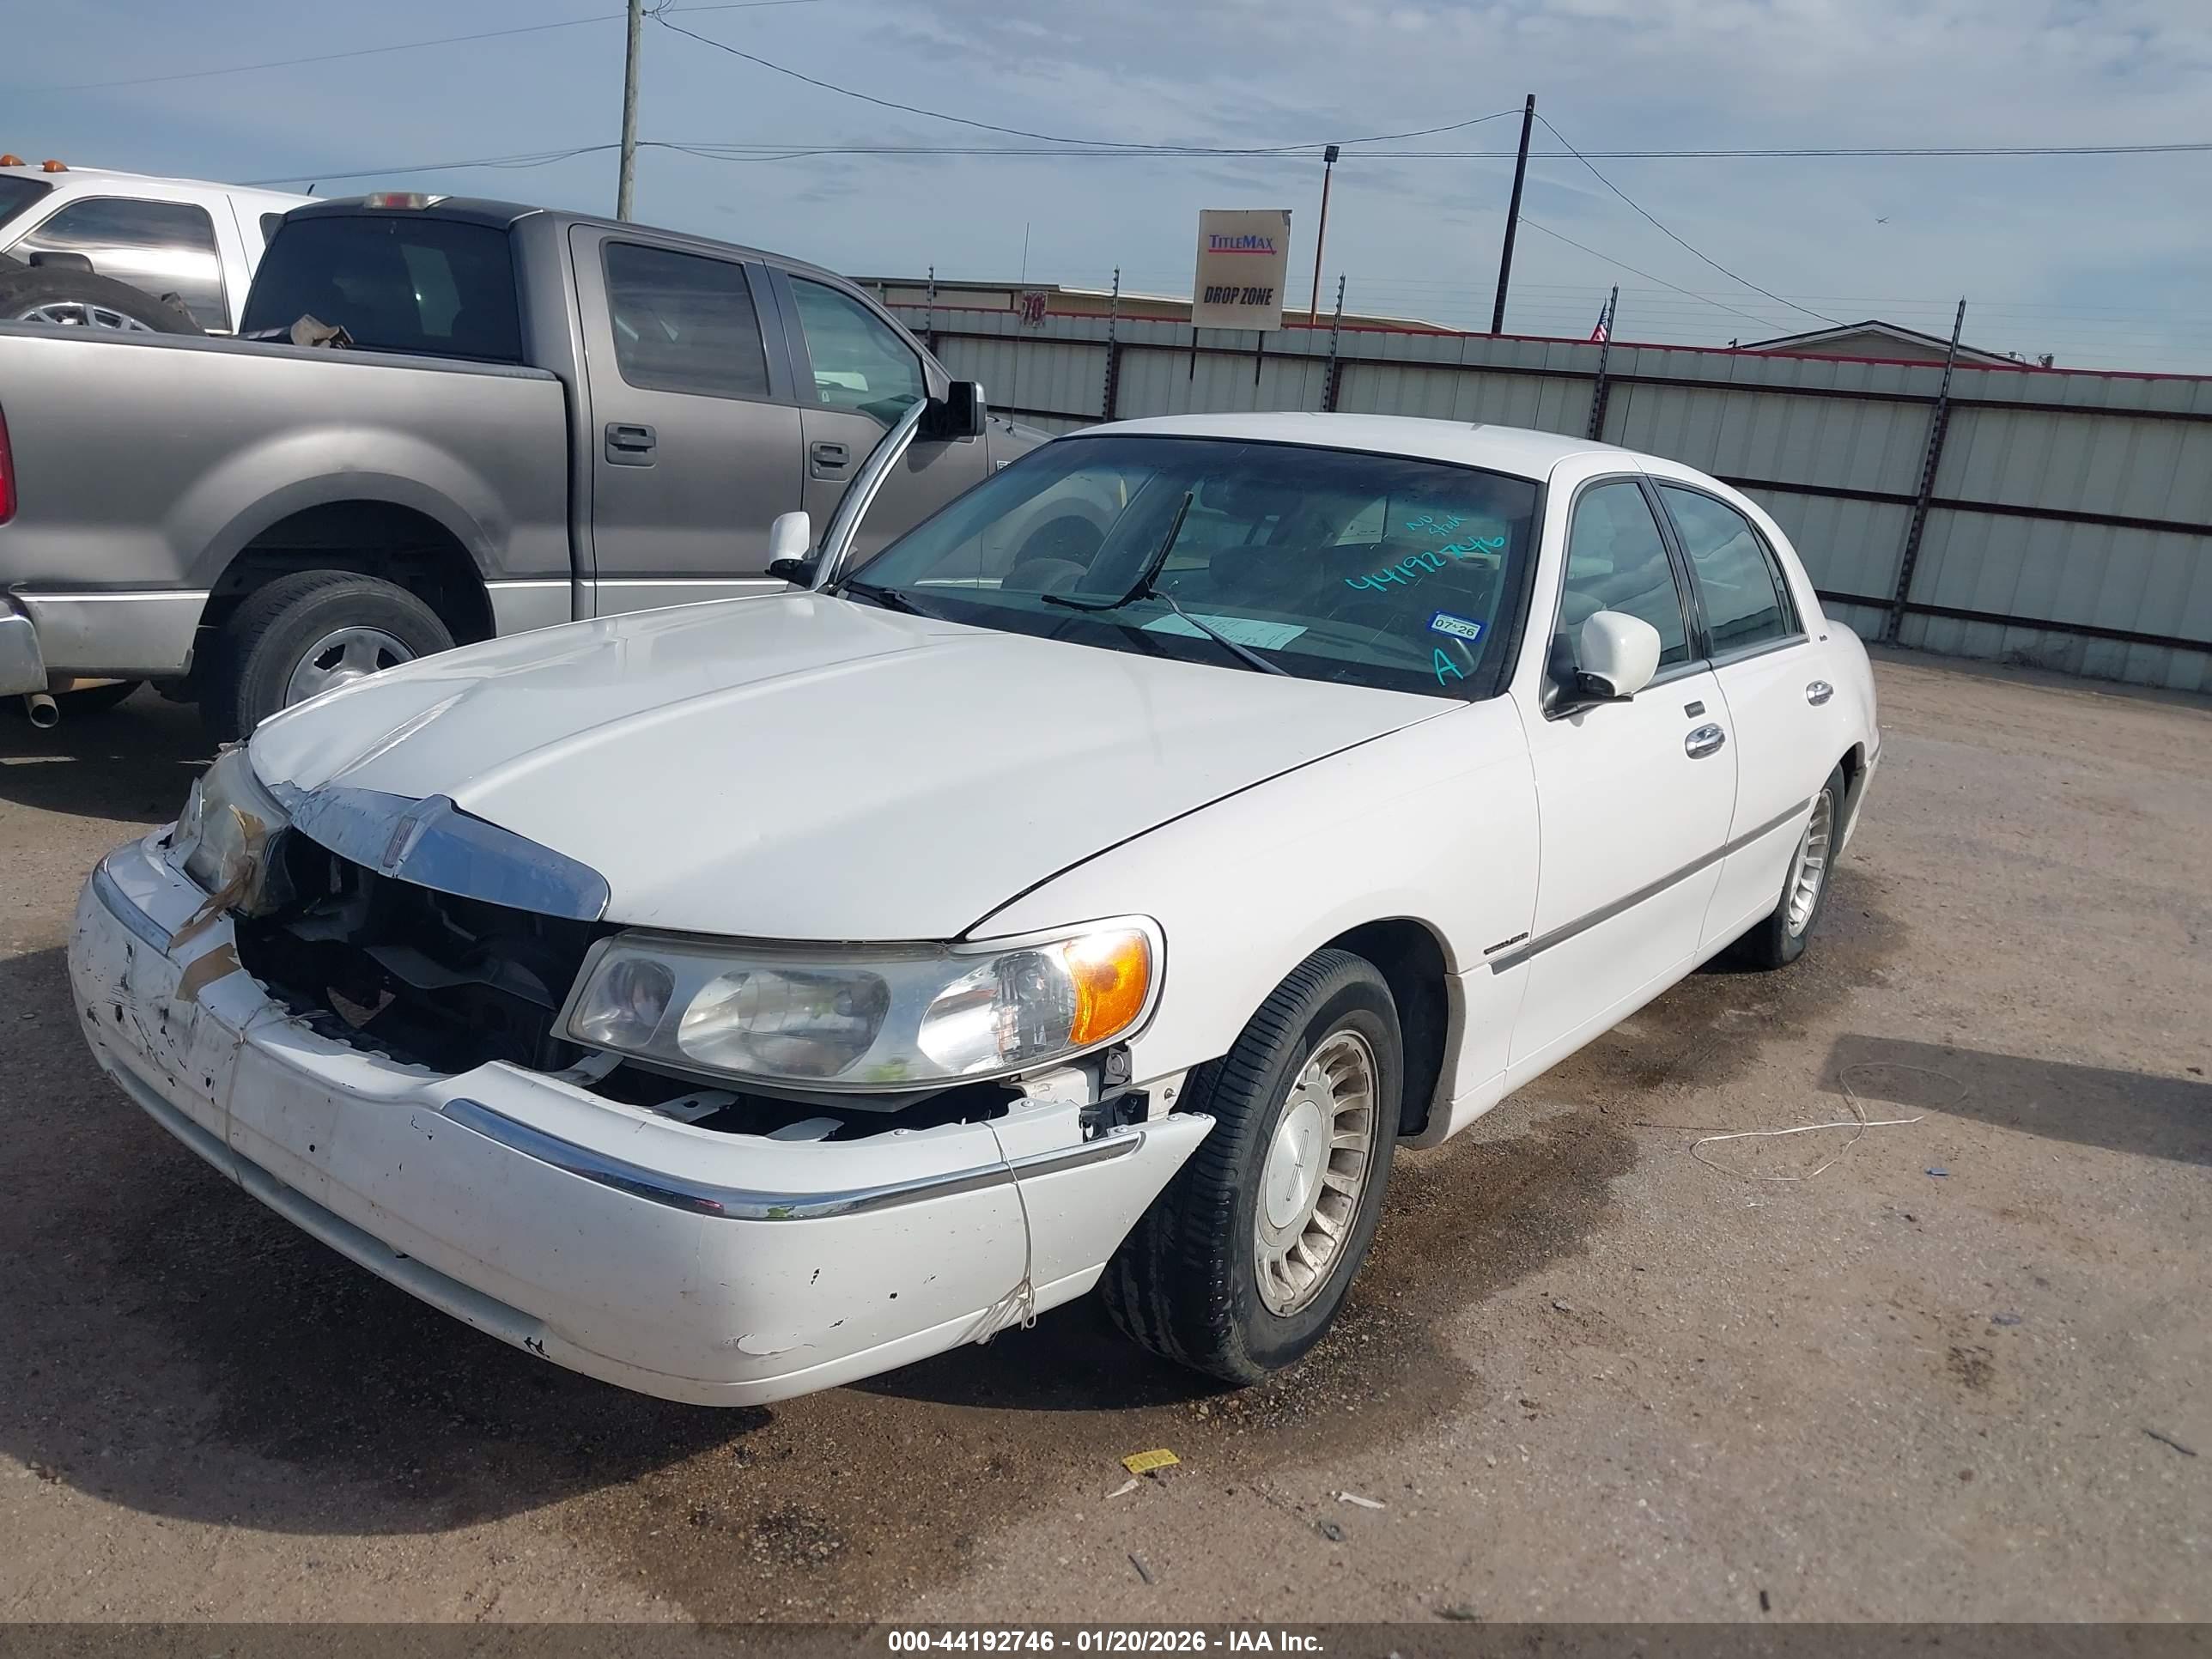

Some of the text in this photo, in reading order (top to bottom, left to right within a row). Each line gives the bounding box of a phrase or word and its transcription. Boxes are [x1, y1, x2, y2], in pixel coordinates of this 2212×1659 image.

[1204, 286, 1274, 306] DROP ZONE
[1345, 536, 1505, 592] 44192746
[1432, 646, 1464, 686] A
